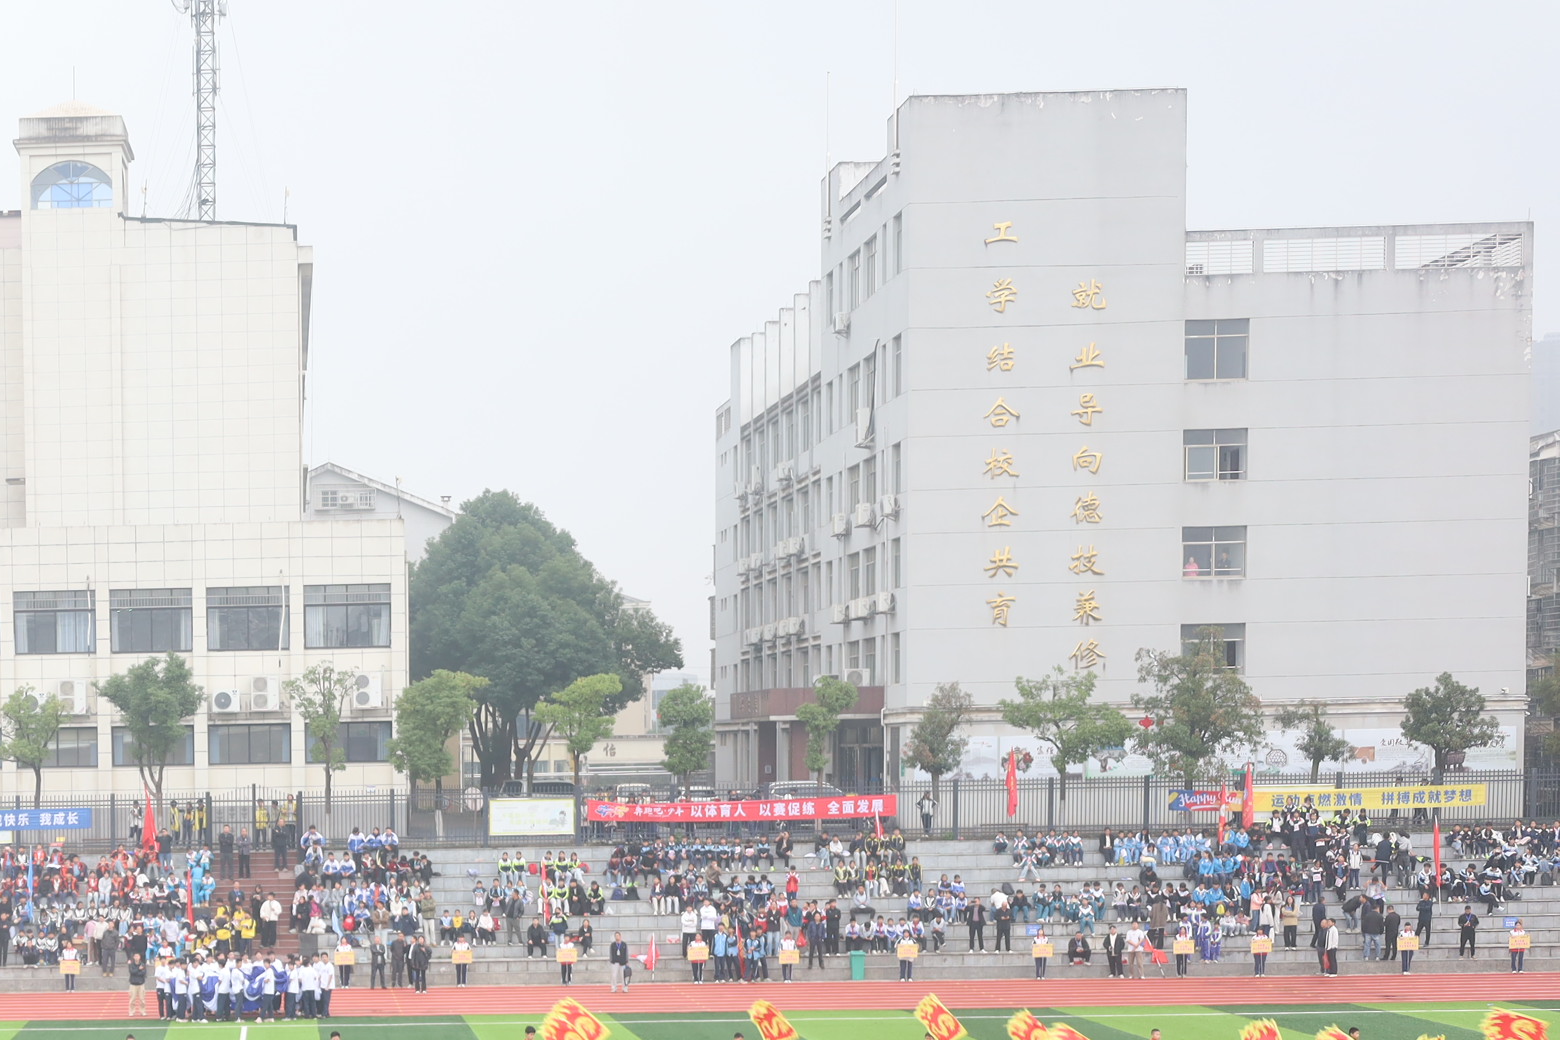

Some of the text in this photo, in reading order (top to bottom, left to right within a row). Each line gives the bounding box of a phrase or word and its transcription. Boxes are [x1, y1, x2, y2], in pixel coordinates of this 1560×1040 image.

[982, 220, 1020, 628] 工学结合校企共育
[1069, 279, 1107, 671] 就业导向德技兼修
[1178, 793, 1216, 807] Happy
[1381, 788, 1472, 805] 拼搏成就梦想
[691, 799, 884, 817] 以体育人 以赛促练 全面发展
[39, 811, 79, 826] 我成长
